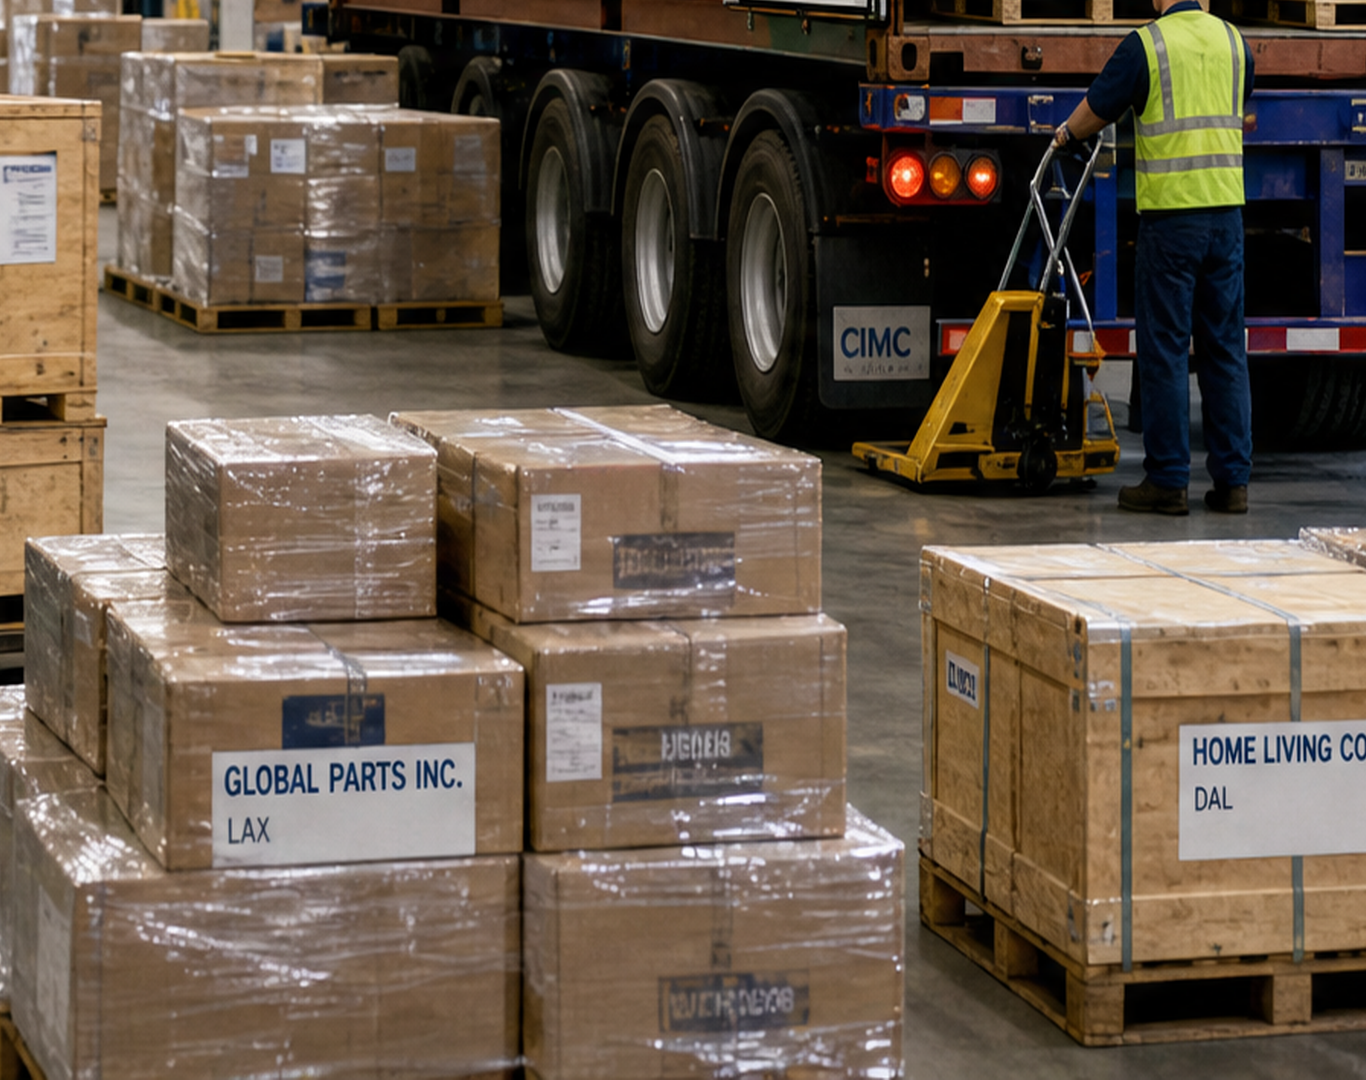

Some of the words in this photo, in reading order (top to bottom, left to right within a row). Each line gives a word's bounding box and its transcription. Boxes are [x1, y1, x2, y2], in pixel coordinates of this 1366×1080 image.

[840, 326, 912, 359] CIMC
[1192, 735, 1257, 766] HOME
[1263, 734, 1333, 764] LIVING
[224, 763, 320, 797] GLOBAL
[329, 760, 407, 794] PARTS
[416, 758, 463, 790] INC.
[1194, 785, 1234, 812] DAL
[227, 816, 271, 845] LAX
